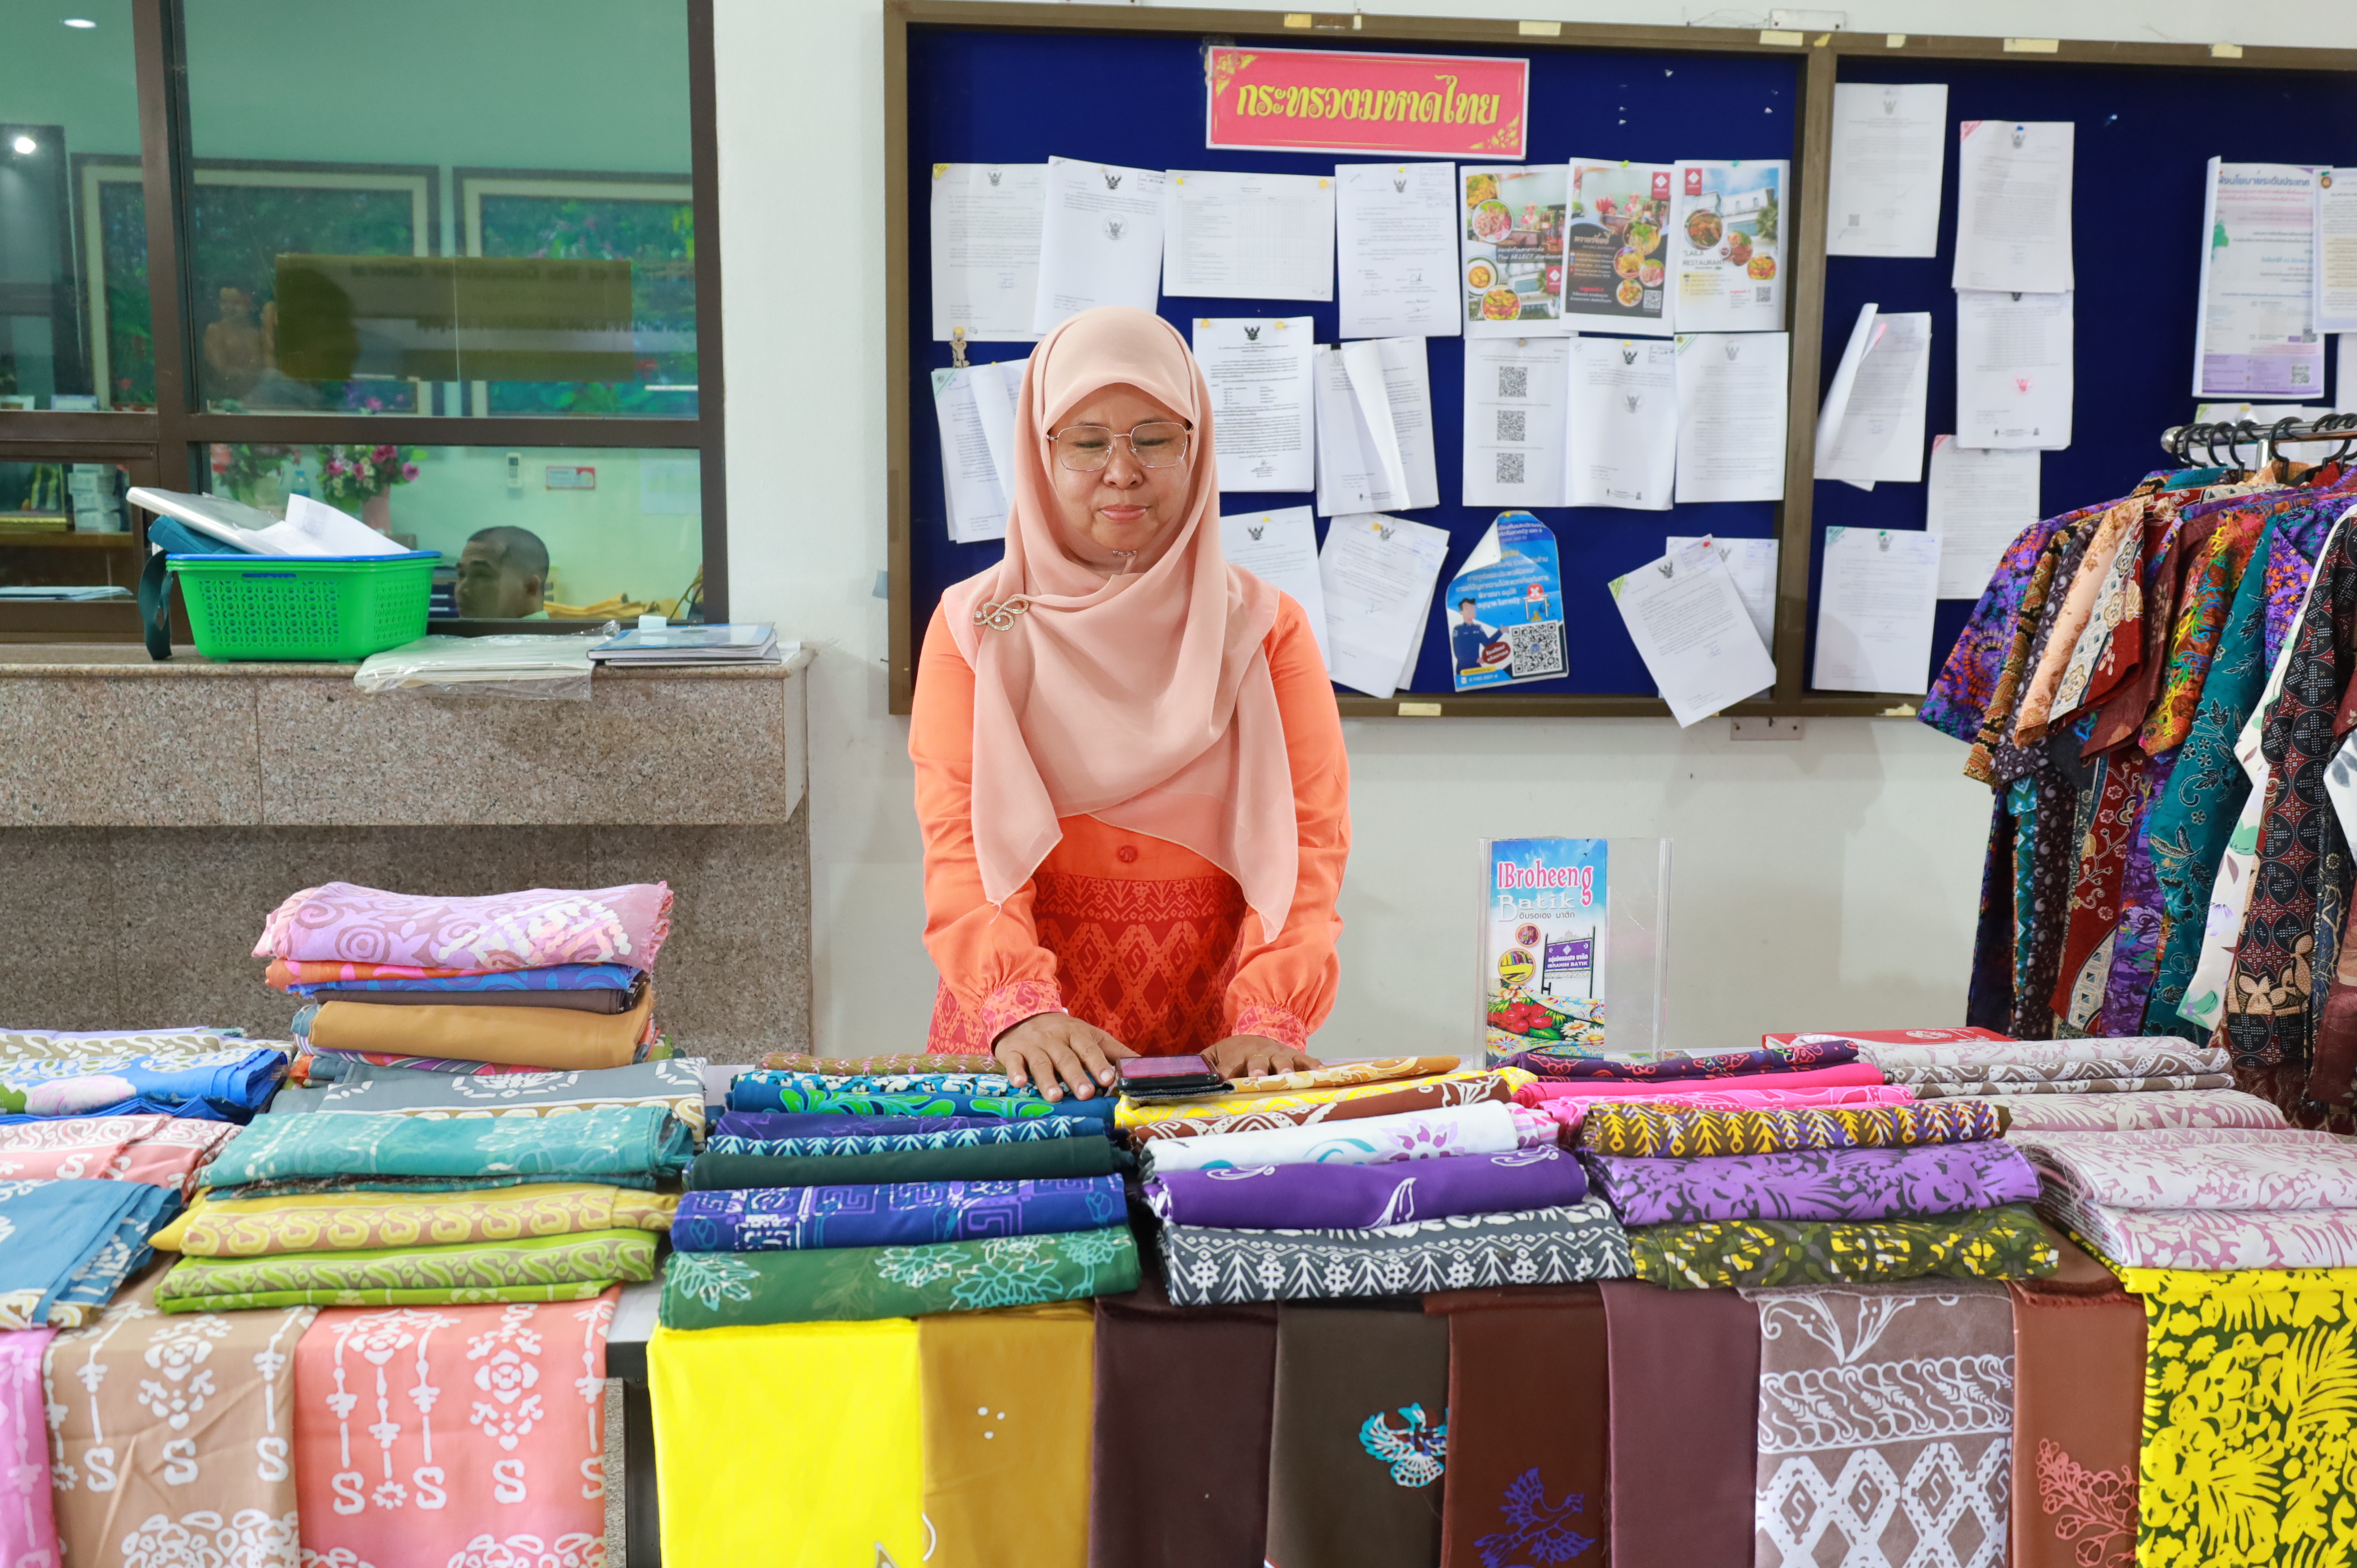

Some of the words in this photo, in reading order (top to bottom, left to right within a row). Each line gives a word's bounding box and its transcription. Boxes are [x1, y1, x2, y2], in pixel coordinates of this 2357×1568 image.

[1236, 74, 1500, 125] กระทรวงมหาดไทย
[1497, 859, 1593, 906] IBroheeng
[1497, 891, 1576, 922] Batik
